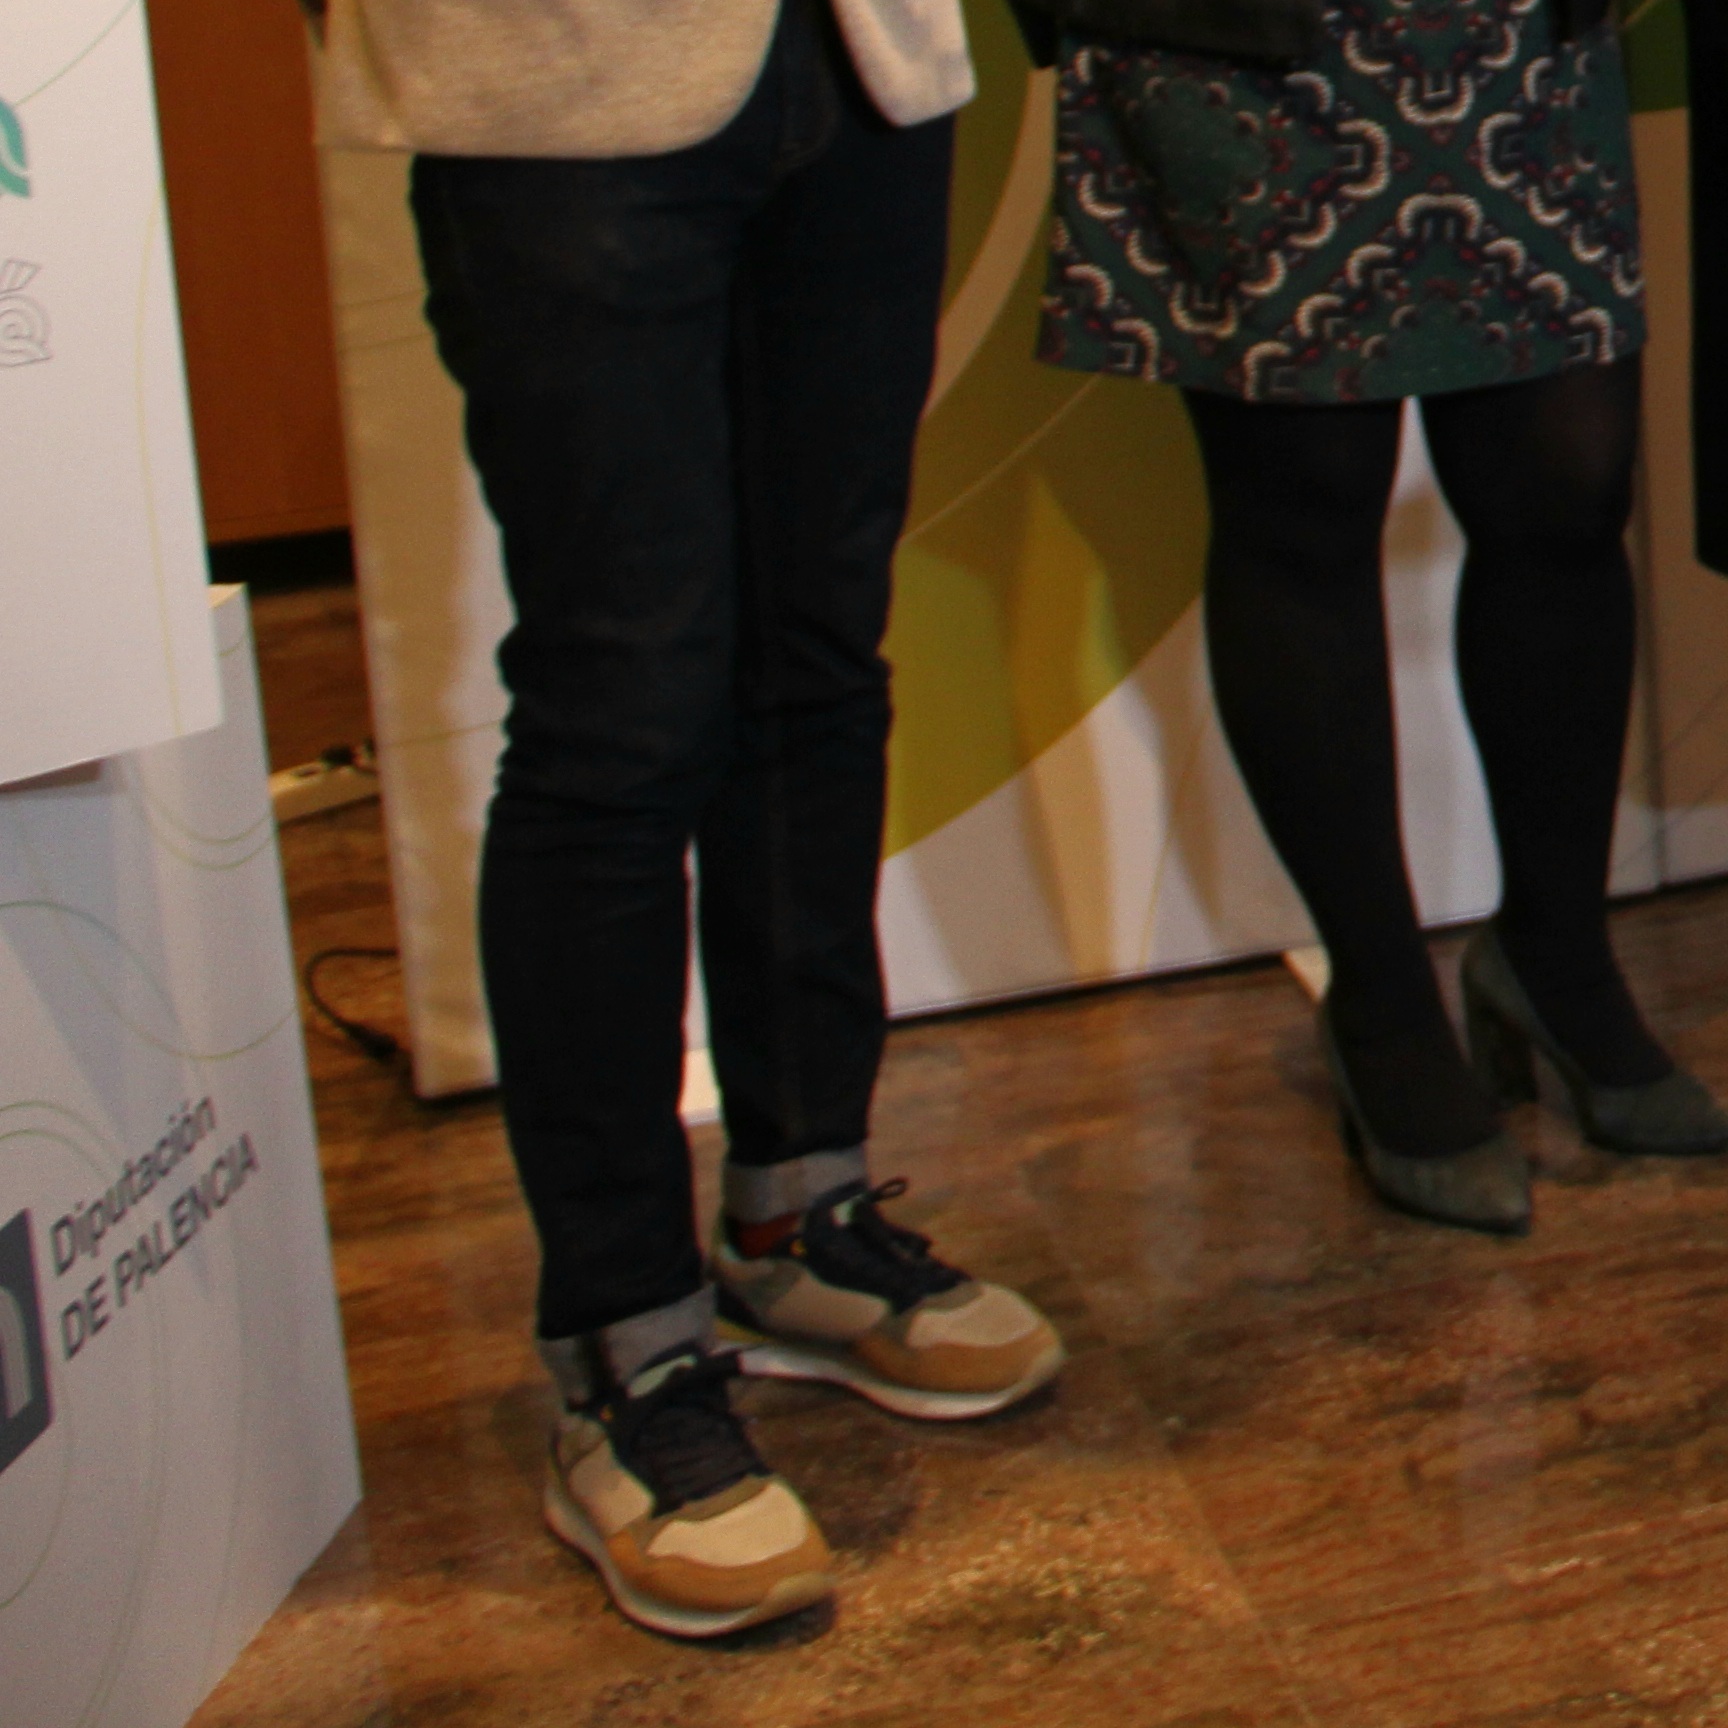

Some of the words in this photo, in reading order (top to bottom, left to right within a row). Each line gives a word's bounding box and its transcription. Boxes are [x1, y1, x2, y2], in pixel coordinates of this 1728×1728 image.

[50, 1095, 217, 1279] Diputación
[61, 1277, 112, 1361] DE
[113, 1131, 260, 1309] PALENCIA
